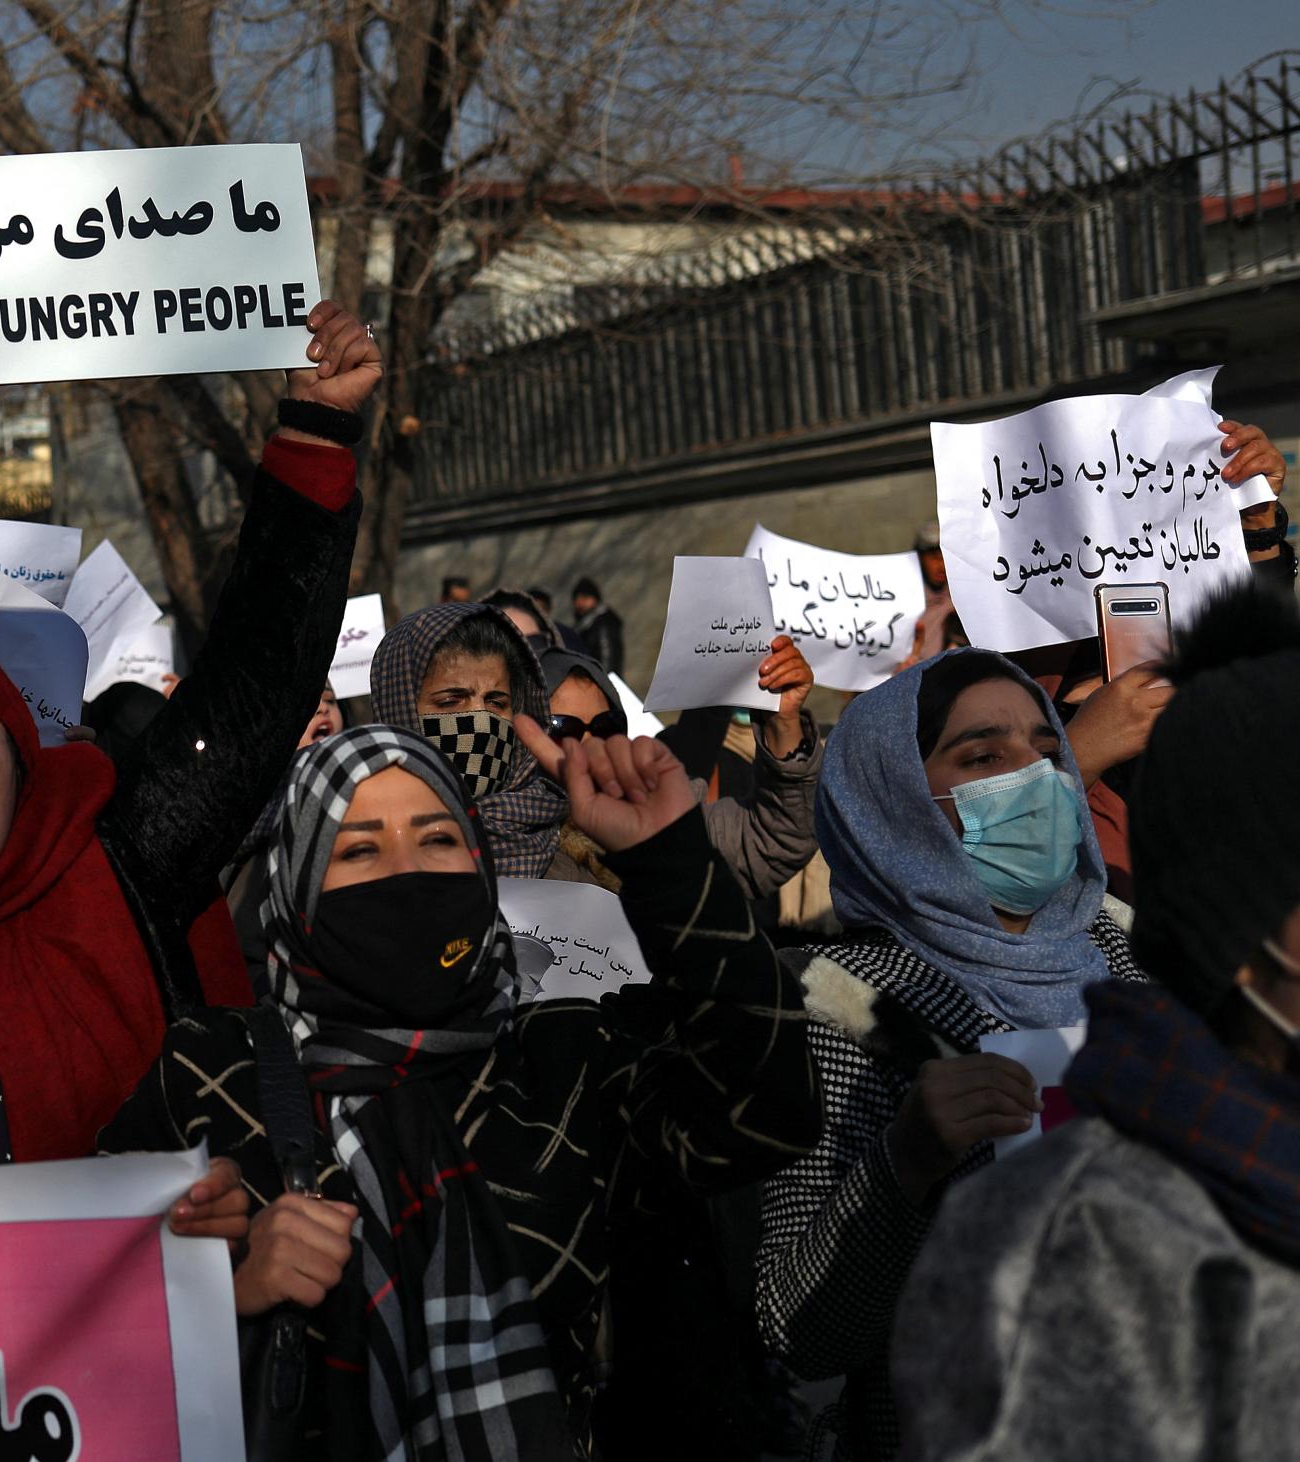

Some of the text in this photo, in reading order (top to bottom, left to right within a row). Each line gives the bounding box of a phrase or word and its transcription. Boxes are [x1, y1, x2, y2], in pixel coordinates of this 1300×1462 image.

[54, 186, 214, 259] صدای
[229, 179, 281, 232] ما
[153, 282, 307, 335] PEOPLE
[981, 429, 1220, 519] جرم و جزا به دلخواه
[1159, 516, 1221, 574] طالبان
[787, 558, 810, 591] ما
[992, 538, 1073, 594] میشود
[817, 572, 896, 607] طالبان
[710, 616, 762, 636] خاموشی ملت
[694, 640, 771, 658] جنایت است جنایت
[541, 932, 569, 948] بس
[573, 936, 610, 959] است
[568, 959, 605, 982] نسل
[609, 959, 634, 981] بس
